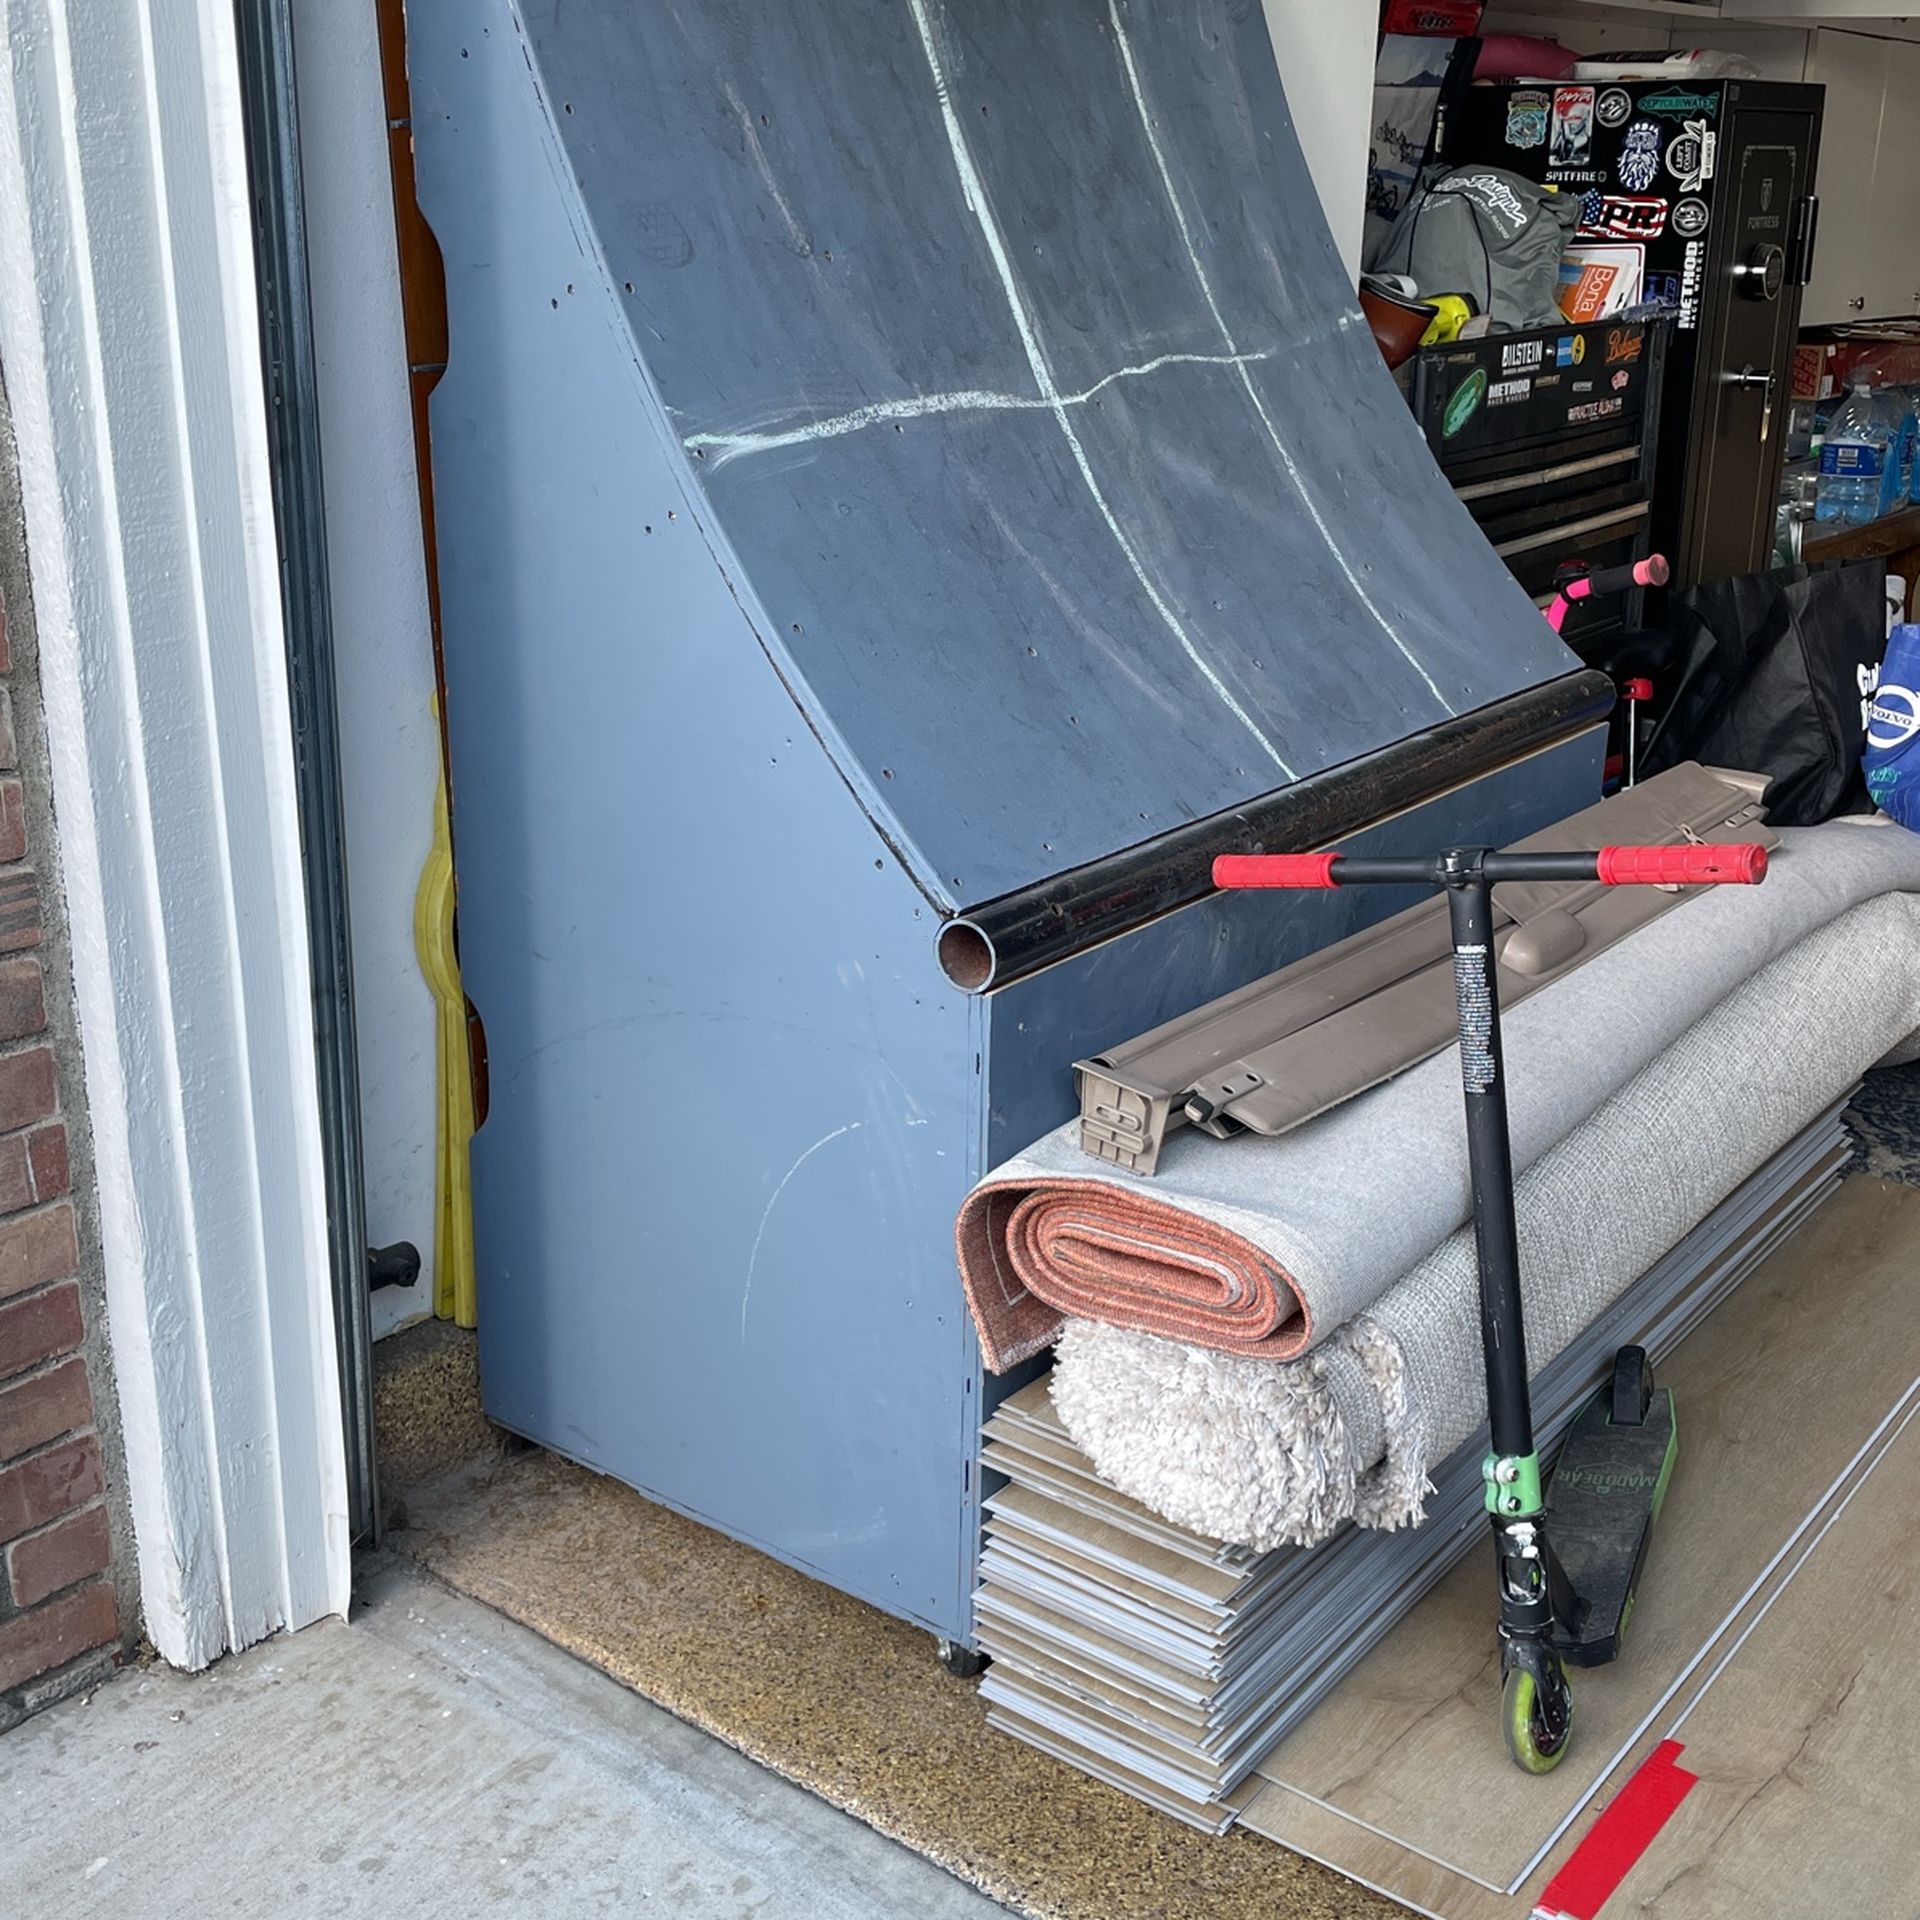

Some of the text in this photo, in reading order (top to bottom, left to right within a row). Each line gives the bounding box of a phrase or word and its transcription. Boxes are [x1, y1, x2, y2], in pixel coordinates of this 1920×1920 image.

[1545, 170, 1597, 183] SPITFIRE
[1747, 215, 1780, 230] FORTRESS
[1580, 267, 1614, 313] Bona
[1678, 241, 1698, 329] METHOD
[1502, 340, 1543, 368] BILSTEIN
[1488, 379, 1530, 399] METHOD
[1870, 706, 1912, 726] VOLVO
